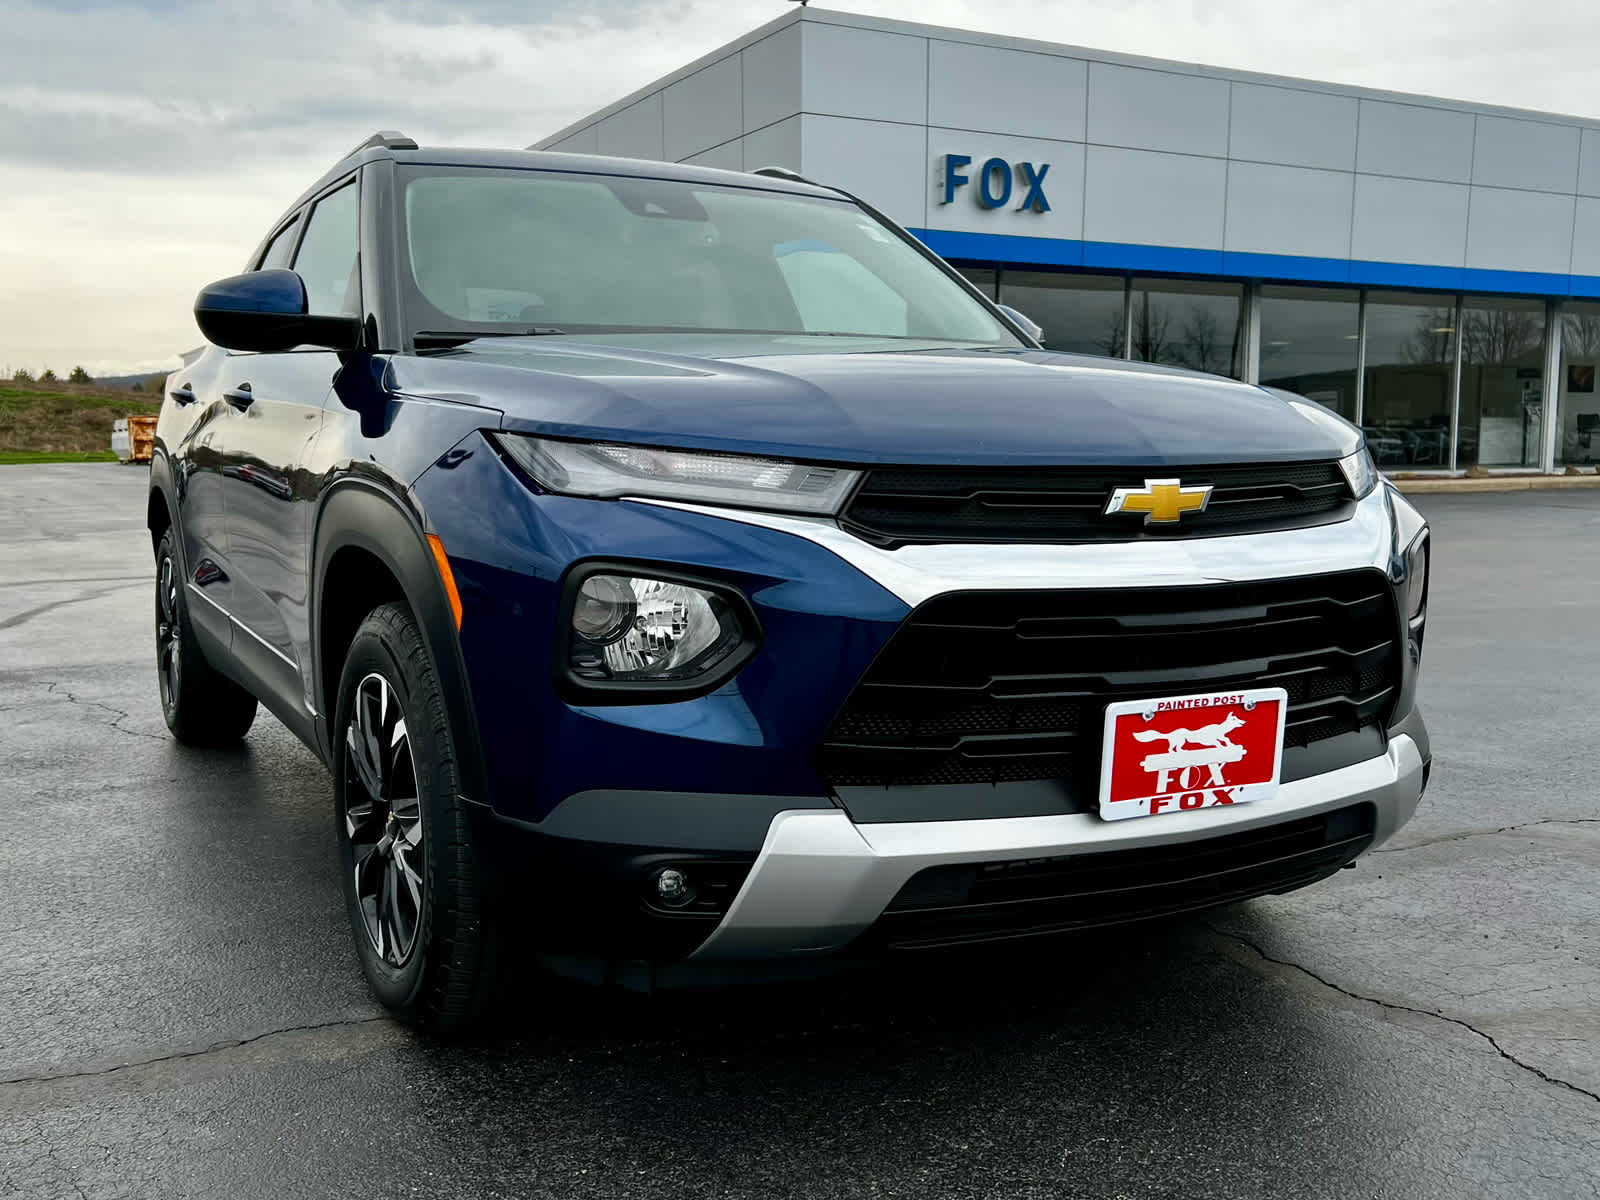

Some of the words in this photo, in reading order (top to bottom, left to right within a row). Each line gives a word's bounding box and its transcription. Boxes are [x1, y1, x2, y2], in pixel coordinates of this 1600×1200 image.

[943, 153, 1051, 212] FOX
[1157, 698, 1209, 711] PAINTED
[1213, 694, 1245, 706] POST
[1155, 761, 1227, 793] FOX
[1149, 787, 1236, 815] FOX
